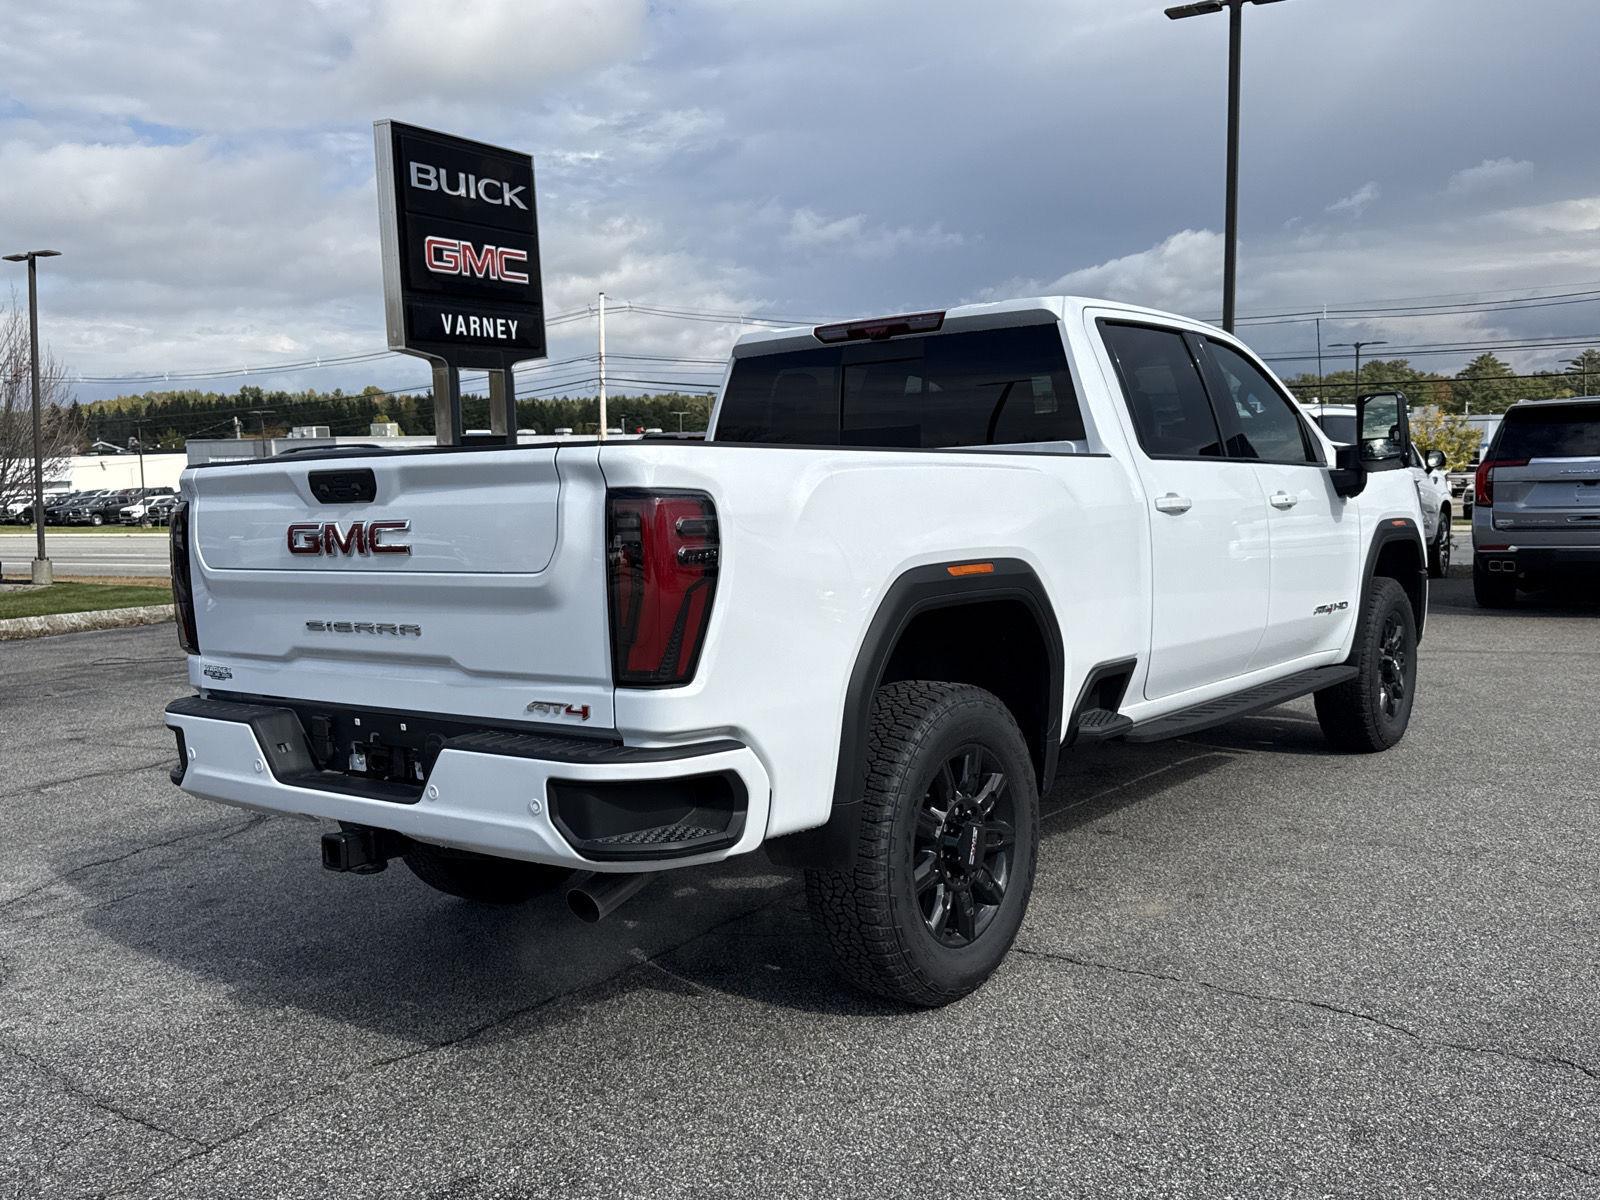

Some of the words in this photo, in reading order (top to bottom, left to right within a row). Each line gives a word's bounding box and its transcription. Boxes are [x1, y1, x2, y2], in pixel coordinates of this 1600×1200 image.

[409, 161, 529, 211] BUICK
[425, 235, 530, 285] GMC
[441, 313, 518, 340] VARNEY
[287, 519, 412, 556] GMC
[1333, 601, 1349, 611] HD
[306, 620, 422, 637] SIERRA
[526, 701, 591, 721] AT4
